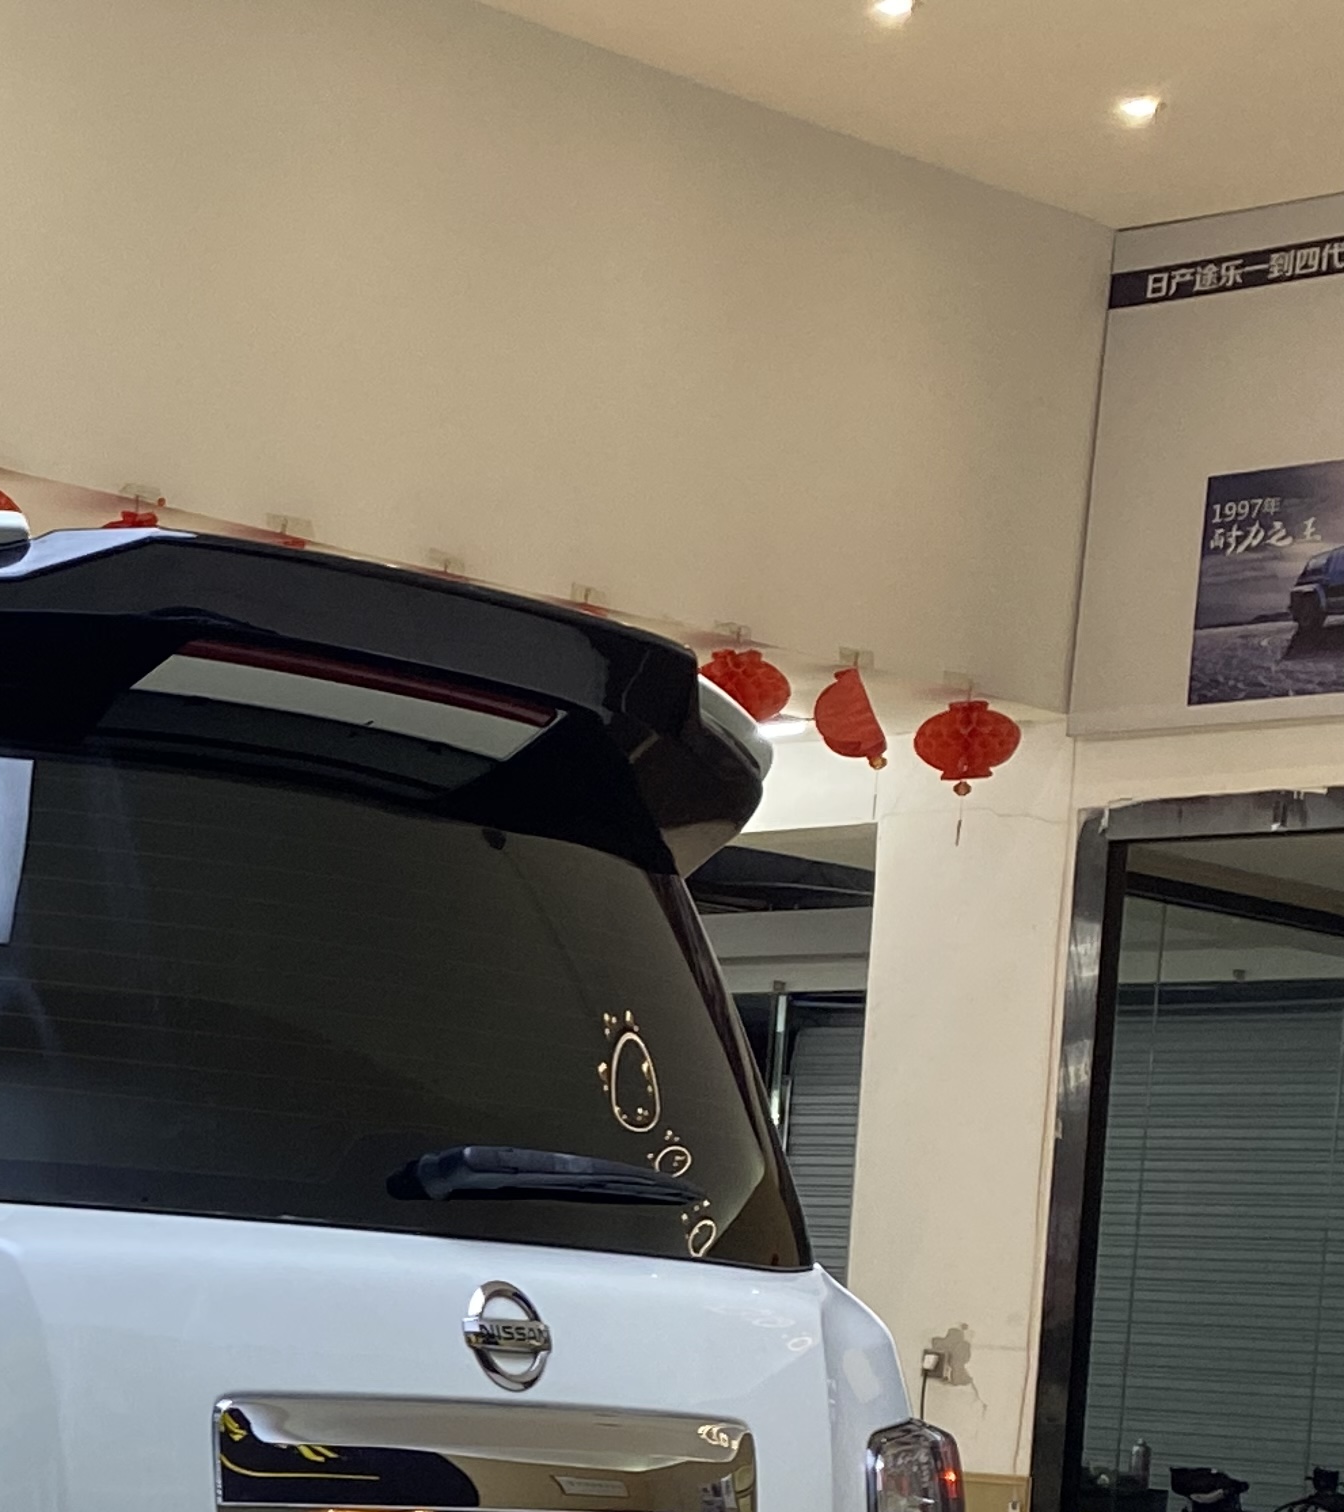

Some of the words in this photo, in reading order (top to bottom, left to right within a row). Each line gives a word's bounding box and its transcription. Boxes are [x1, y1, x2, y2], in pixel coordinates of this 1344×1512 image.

[1211, 496, 1281, 524] 1997年
[1209, 516, 1323, 556] 耐力之王
[478, 1324, 550, 1344] NISSAN
